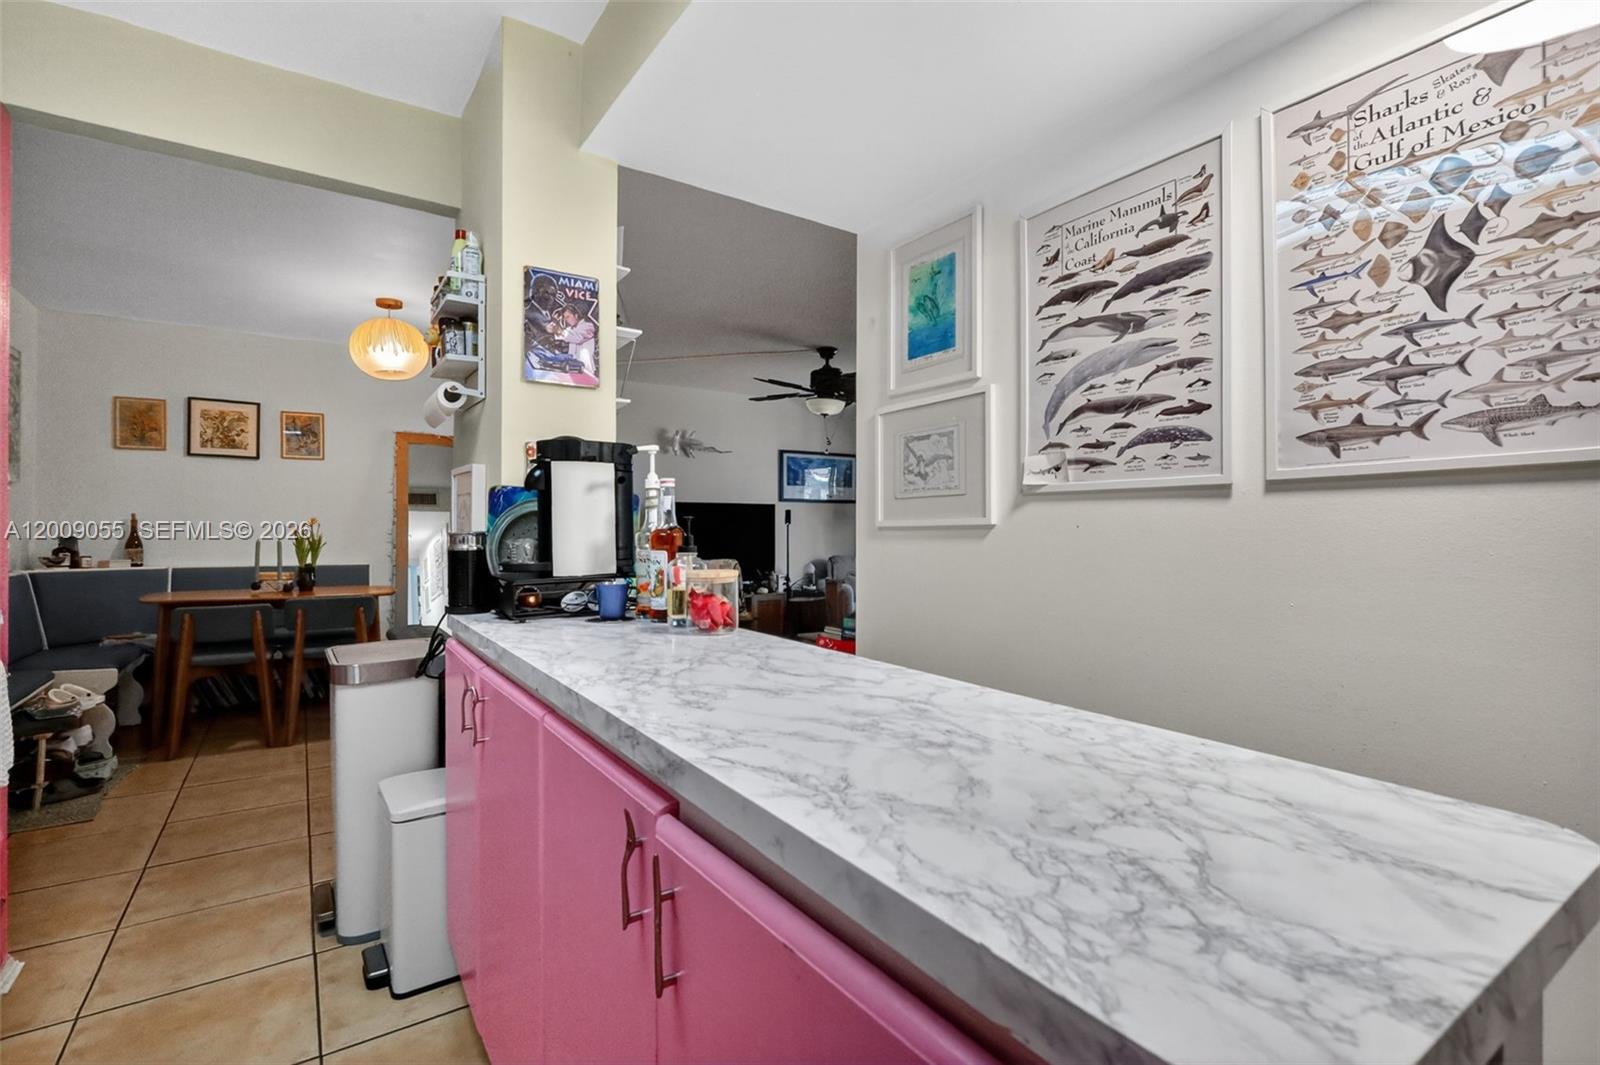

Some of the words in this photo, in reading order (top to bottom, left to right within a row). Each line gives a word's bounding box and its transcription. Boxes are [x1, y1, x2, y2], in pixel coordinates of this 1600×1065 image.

[1432, 62, 1473, 89] Skates
[1449, 72, 1478, 93] Rays
[1353, 88, 1429, 128] Sharks
[1368, 102, 1464, 146] Atlantic
[1472, 87, 1493, 107] &
[1352, 129, 1364, 142] of
[1353, 137, 1405, 171] Gulf
[1411, 126, 1435, 153] of
[1441, 102, 1537, 144] Mexico
[1353, 140, 1369, 151] the
[1064, 216, 1107, 240] Marine
[1109, 186, 1173, 223] Mammals
[1074, 222, 1136, 252] California
[1064, 252, 1096, 271] Coast
[558, 276, 599, 292] MIAMI
[565, 287, 592, 301] VICE
